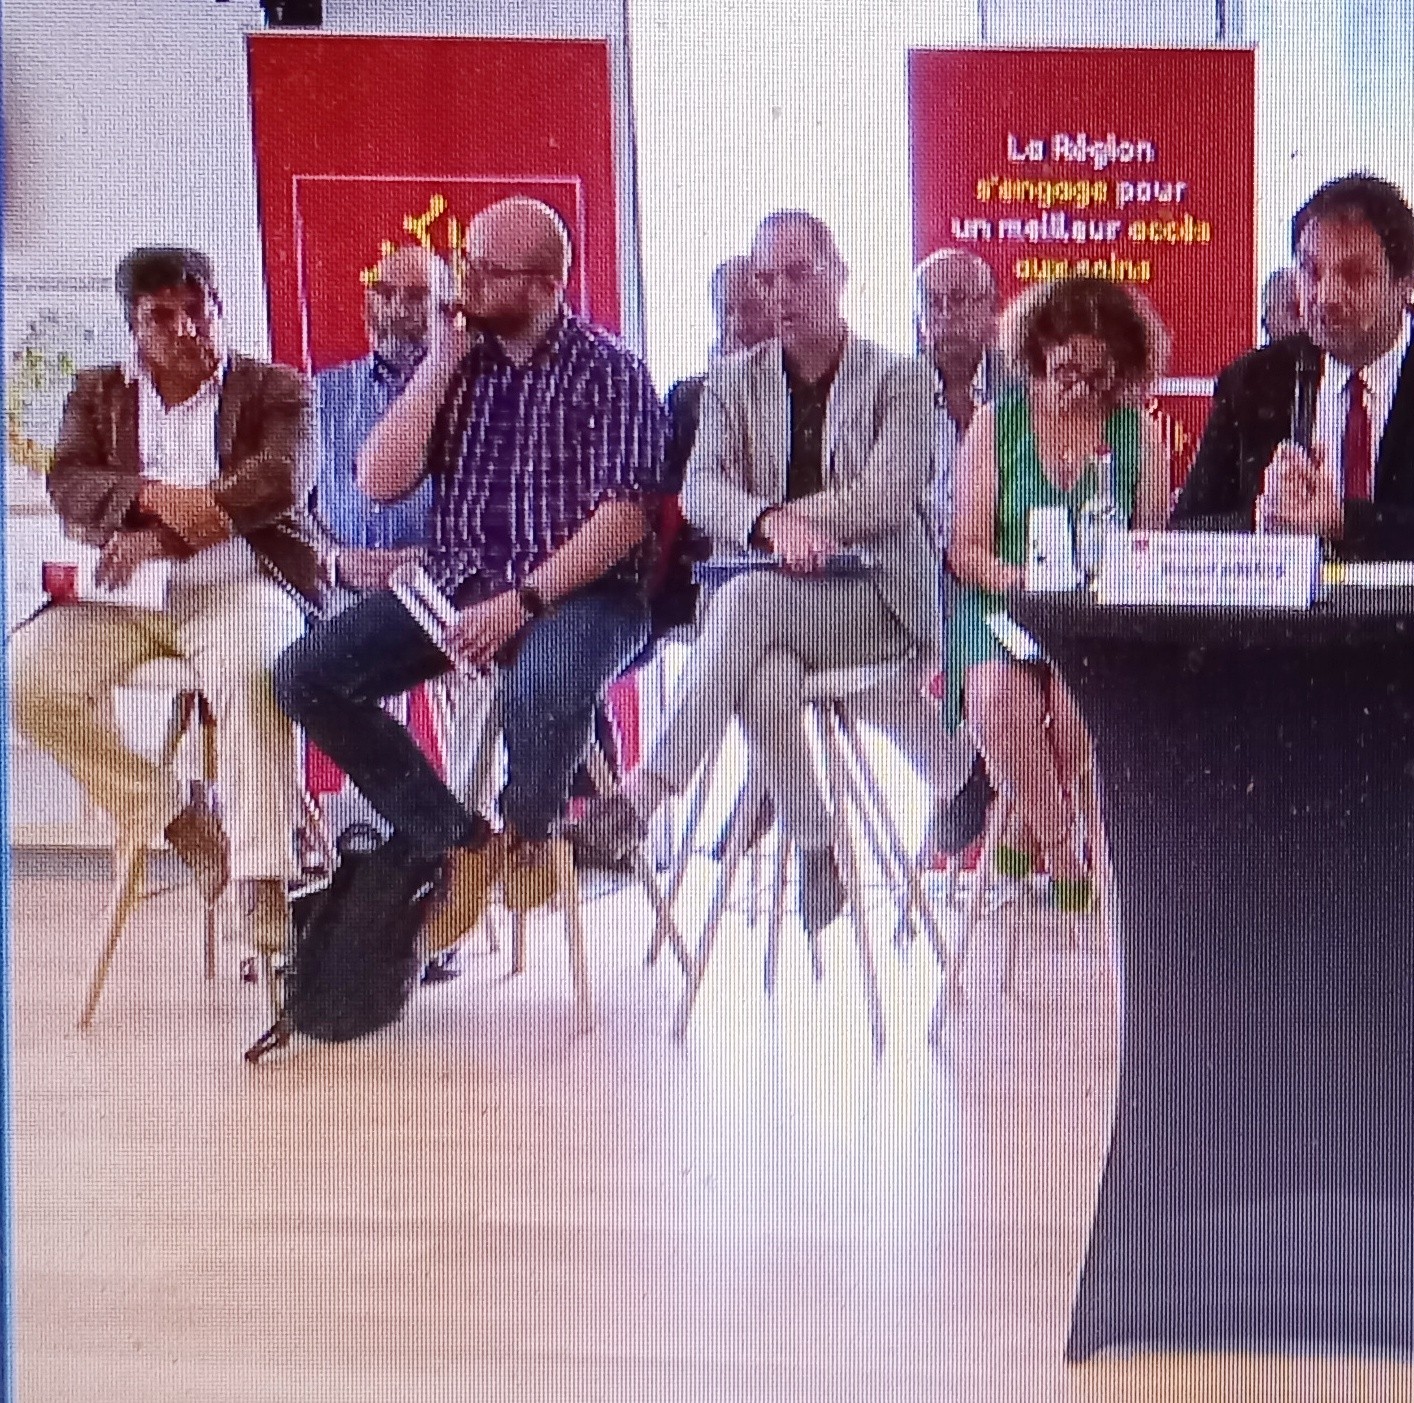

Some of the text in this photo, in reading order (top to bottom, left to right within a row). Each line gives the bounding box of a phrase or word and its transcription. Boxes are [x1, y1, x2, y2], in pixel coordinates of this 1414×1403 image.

[1008, 132, 1156, 170] La Région
[976, 176, 1188, 209] s'engage pour
[951, 211, 1212, 244] un meilleur accès
